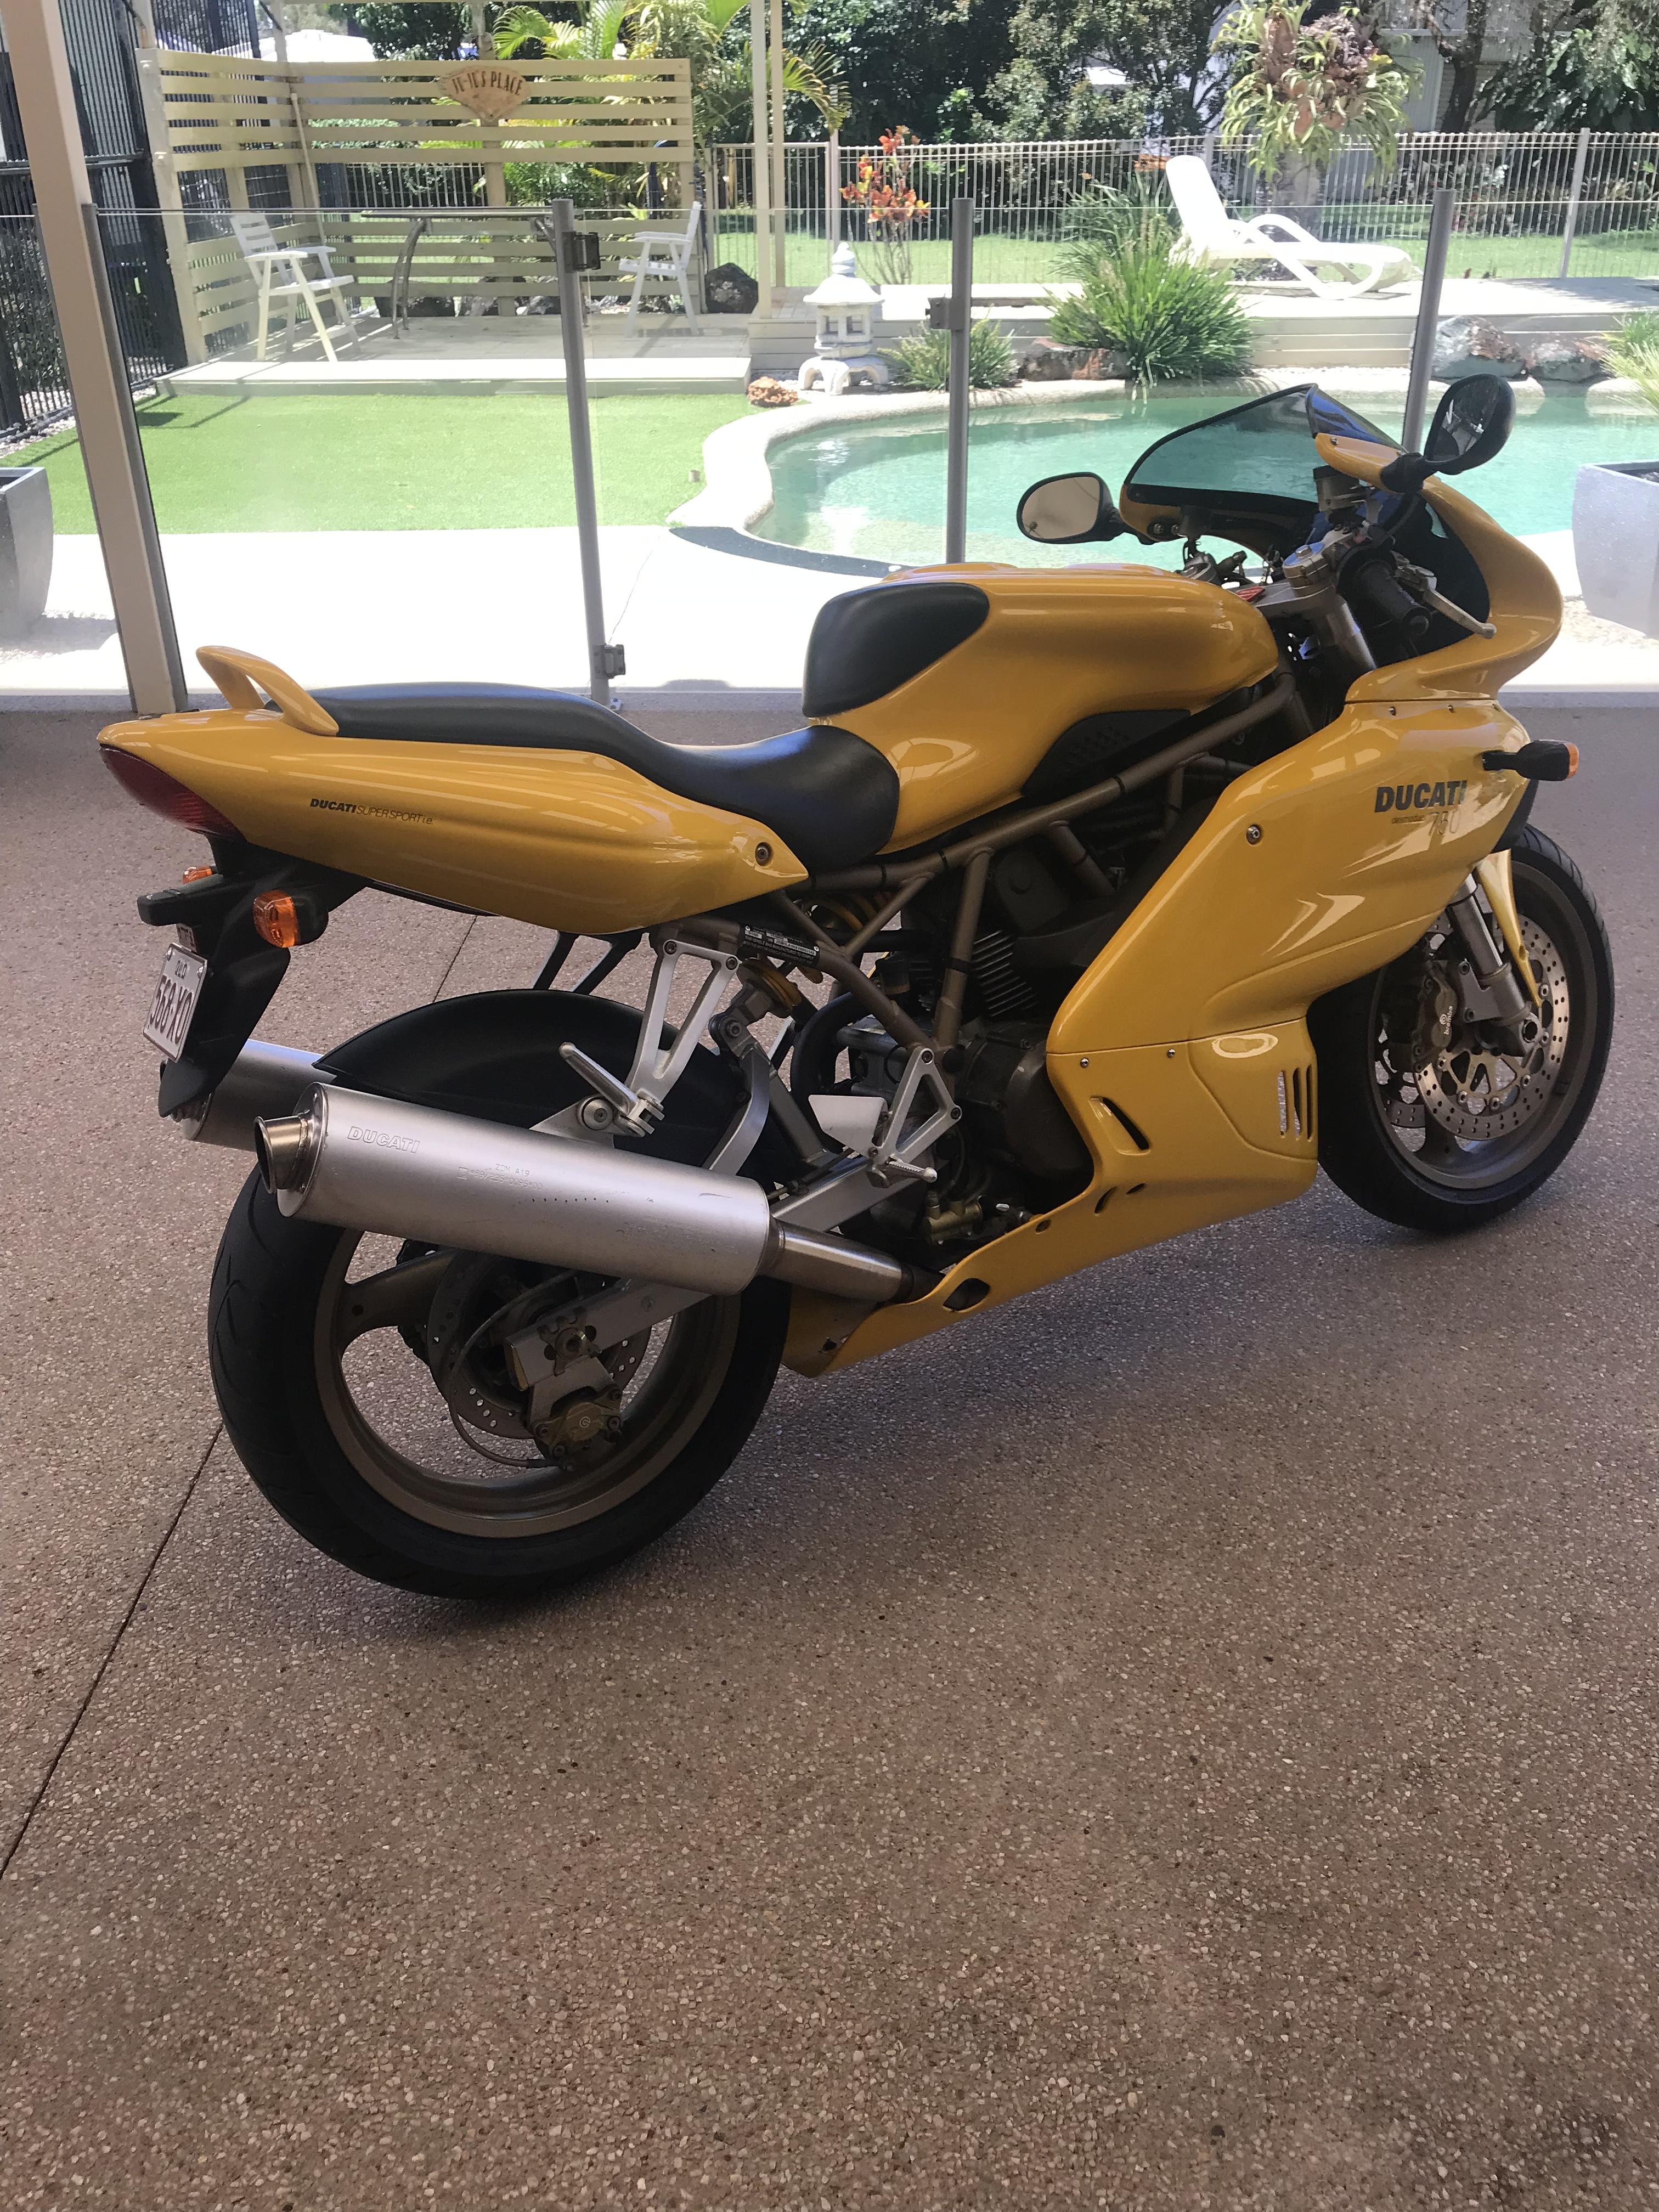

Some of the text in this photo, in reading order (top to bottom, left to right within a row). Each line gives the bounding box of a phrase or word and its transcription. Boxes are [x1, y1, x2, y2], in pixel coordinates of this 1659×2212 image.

[490, 71, 523, 96] PLACE
[310, 798, 357, 813] DUCATI
[1374, 780, 1468, 813] DUCATI
[347, 1126, 420, 1154] DUCATI
